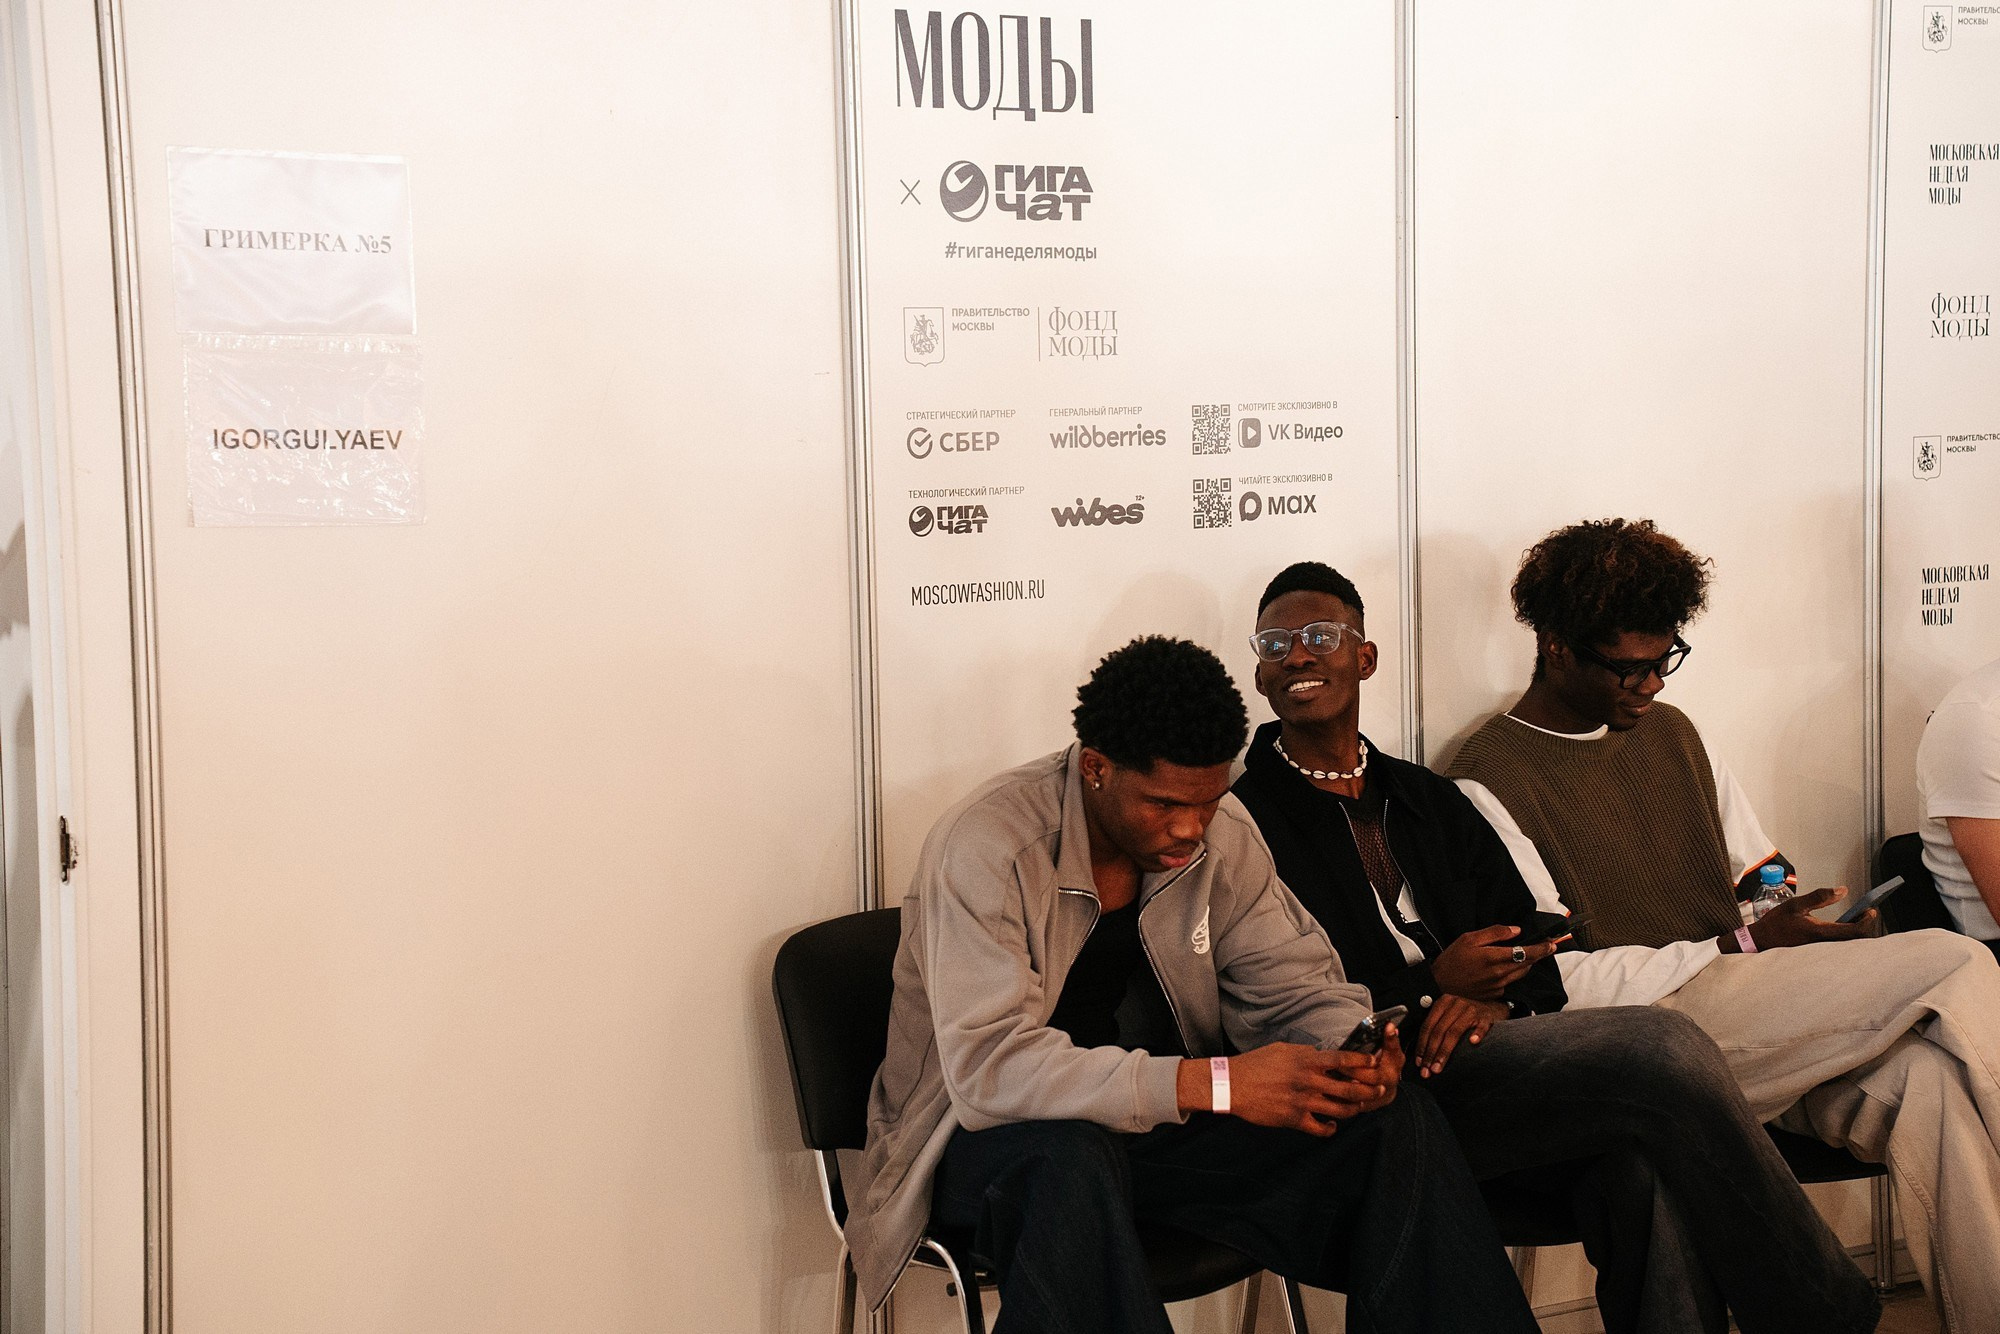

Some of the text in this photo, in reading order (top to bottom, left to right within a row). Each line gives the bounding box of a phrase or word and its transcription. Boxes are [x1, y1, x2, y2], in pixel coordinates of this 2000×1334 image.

[1957, 17, 1989, 25] МОСКВЫ
[895, 9, 1093, 121] МОДЫ
[1930, 144, 1999, 160] МОСКОВСКАЯ
[995, 165, 1093, 192] ГИГА
[1930, 166, 1968, 183] НЕДЕЛЯ
[1929, 188, 1960, 205] МОДЫ
[203, 228, 391, 253] ГРИМЕРКА №5
[944, 242, 1097, 261] #гиганеделямоды
[952, 307, 1030, 317] ПРАВИТЕЛЬСТВО
[1931, 293, 1990, 319] ФОНД
[951, 321, 995, 332] МОСКВЫ
[1049, 307, 1117, 335] ФОНД
[1931, 318, 1990, 341] МОДЫ
[1048, 336, 1118, 361] МОДЫ
[906, 409, 1016, 421] СТРАТЕГИЧЕСКИЙ ПАРТНЕР
[1049, 406, 1143, 417] ГЕНЕРАЛЬНЫЙ ПАРТНЕР
[1237, 401, 1338, 412] СМОТРИТЕ ЭКСКЛЮЗИВНО В
[214, 429, 402, 449] IGORGULYAEV
[940, 432, 999, 452] СБЕР
[1050, 424, 1166, 448] wildberries
[1268, 424, 1343, 442] VK Видео
[1946, 445, 1977, 453] МОСКВЫ
[1238, 473, 1333, 485] ЧИТАЙТЕ ЭКСКЛЮЗИВНО В
[908, 486, 1025, 499] ТЕХНОЛОГИЧЕСКИЙ ПАРТНЕР
[937, 505, 989, 519] ГИГА
[1922, 564, 1990, 585] МОСКОВСКАЯ
[911, 579, 1045, 606] MOSCOWFASHION.RU
[1922, 587, 1960, 606] НЕДЕЛЯ
[1921, 608, 1953, 626] МОДЫ
